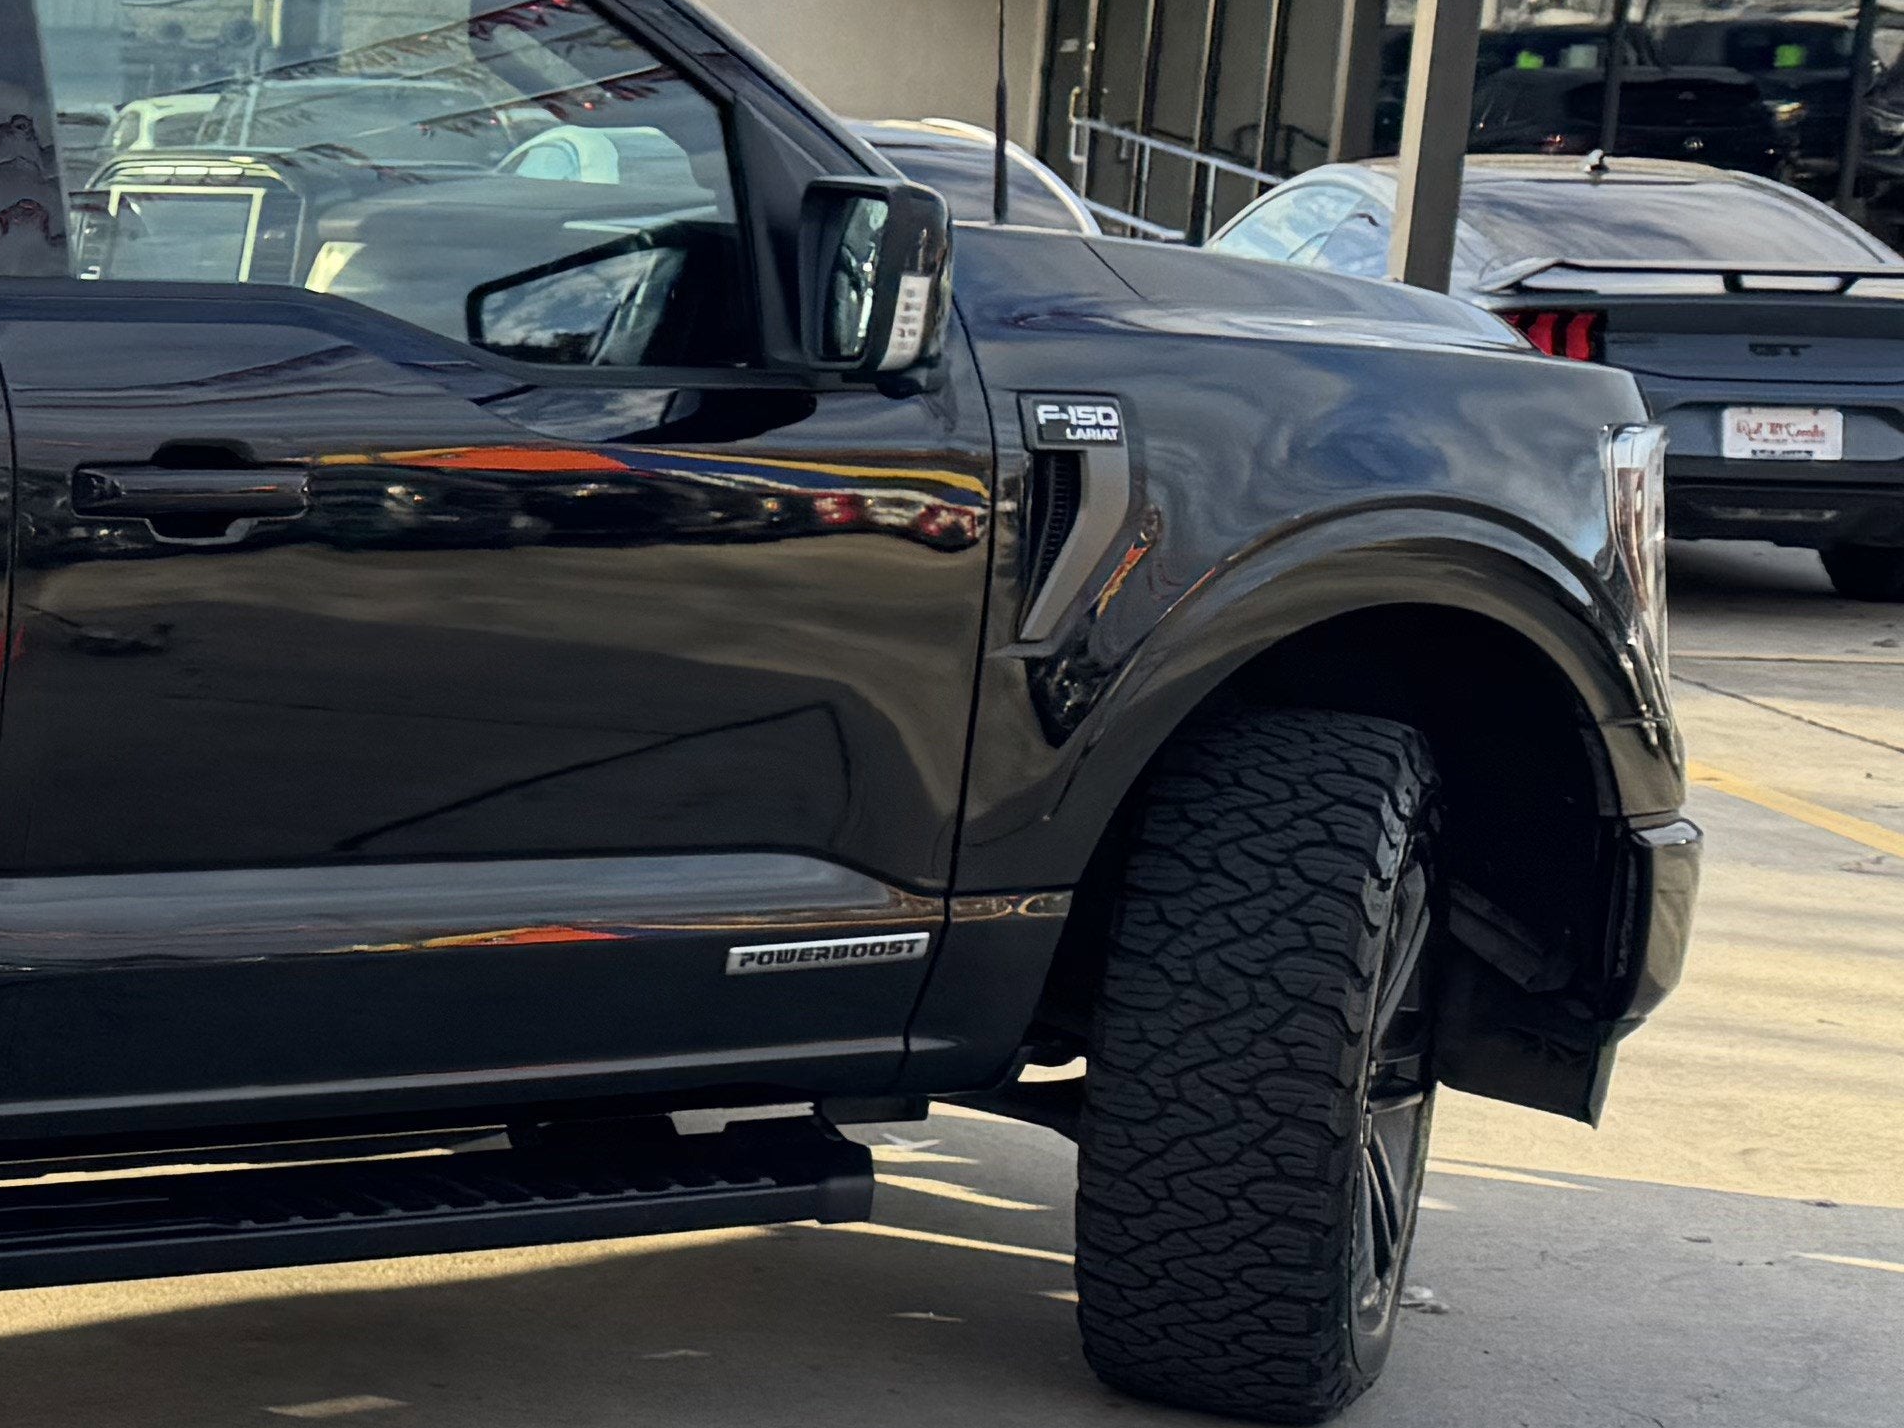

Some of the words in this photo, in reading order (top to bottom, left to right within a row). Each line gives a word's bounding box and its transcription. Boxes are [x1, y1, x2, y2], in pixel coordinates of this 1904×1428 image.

[1037, 405, 1119, 426] F-150
[1066, 428, 1118, 441] LARIAT
[739, 939, 921, 967] POWERBOOST
